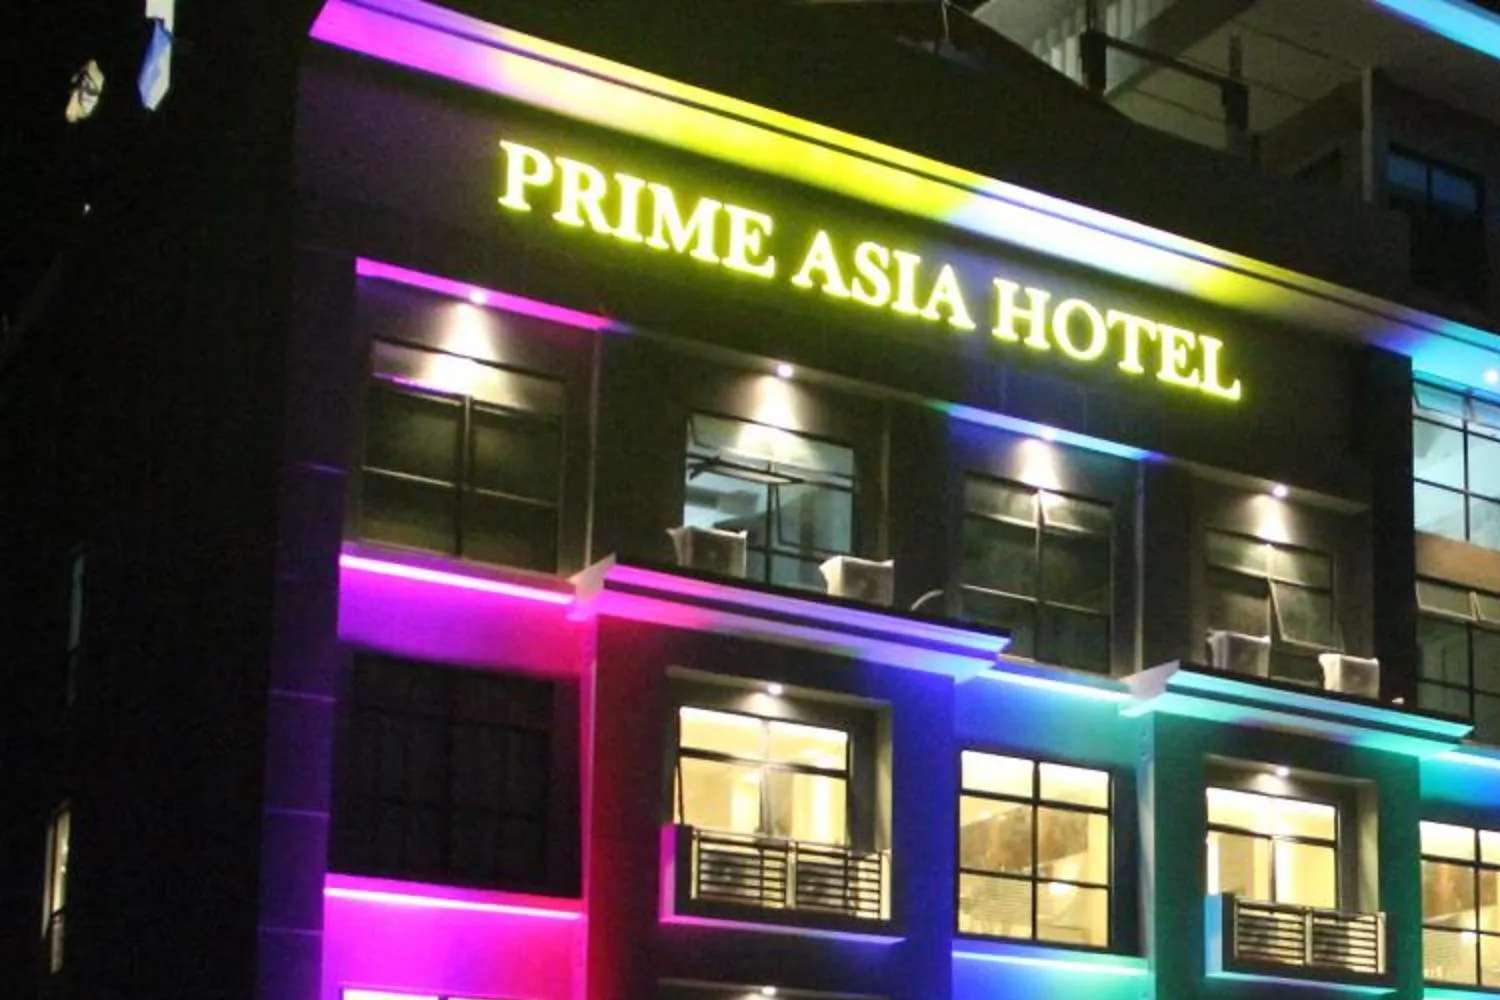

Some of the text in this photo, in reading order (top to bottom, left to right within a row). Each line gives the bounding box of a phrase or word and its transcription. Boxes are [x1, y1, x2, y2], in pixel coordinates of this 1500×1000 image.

[497, 138, 1243, 402] PRIME ASIA HOTEL
